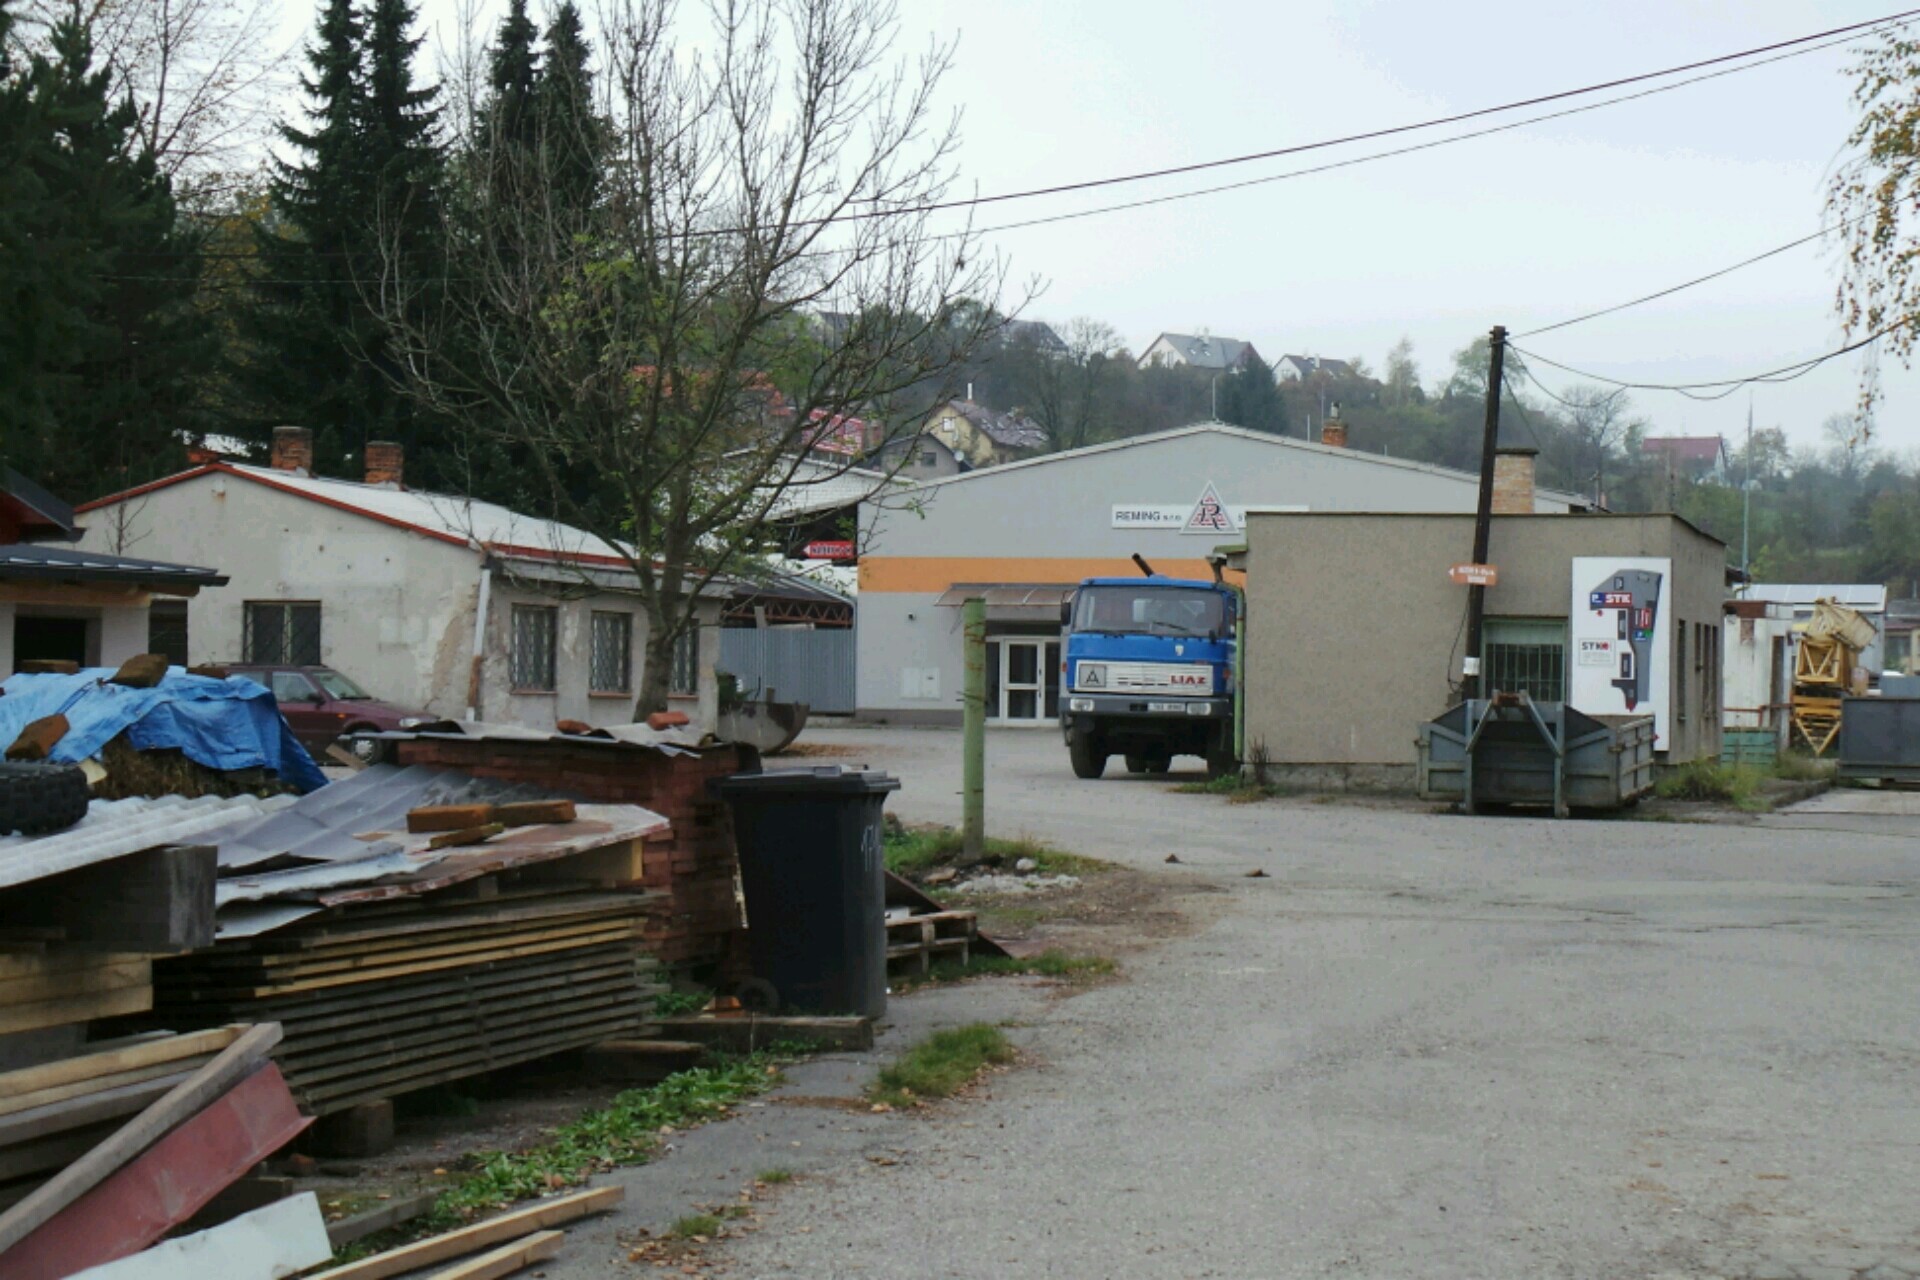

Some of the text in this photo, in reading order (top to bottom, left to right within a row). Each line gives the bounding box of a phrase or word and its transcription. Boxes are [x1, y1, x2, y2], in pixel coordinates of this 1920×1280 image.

[1115, 511, 1160, 521] REMING
[1605, 593, 1631, 604] STK
[1086, 670, 1099, 684] A
